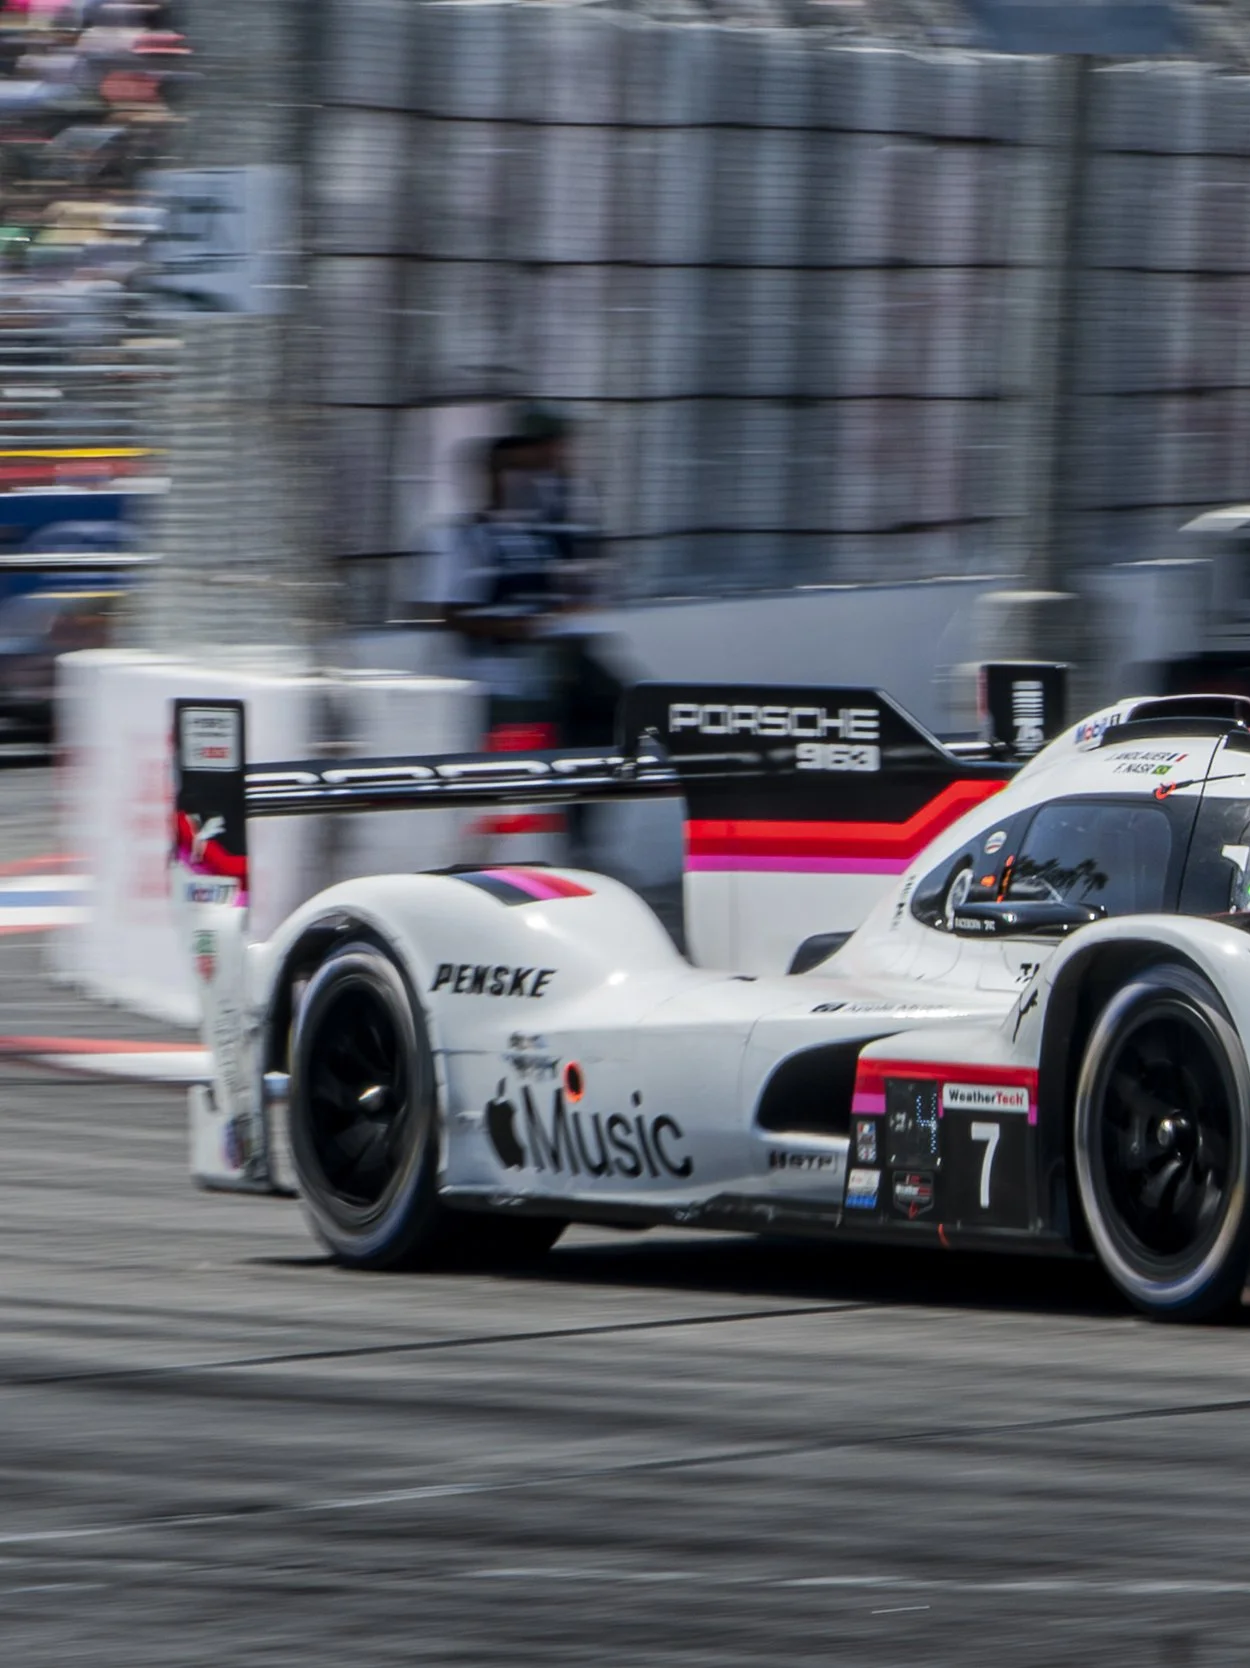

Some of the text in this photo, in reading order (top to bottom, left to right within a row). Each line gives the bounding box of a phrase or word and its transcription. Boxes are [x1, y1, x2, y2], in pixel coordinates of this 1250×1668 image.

[669, 703, 880, 739] PORSCHE
[796, 743, 880, 771] 963
[430, 963, 557, 998] PENSKE
[949, 1089, 1024, 1106] WeatherTech
[521, 1085, 693, 1179] Music
[970, 1121, 1001, 1209] 7
